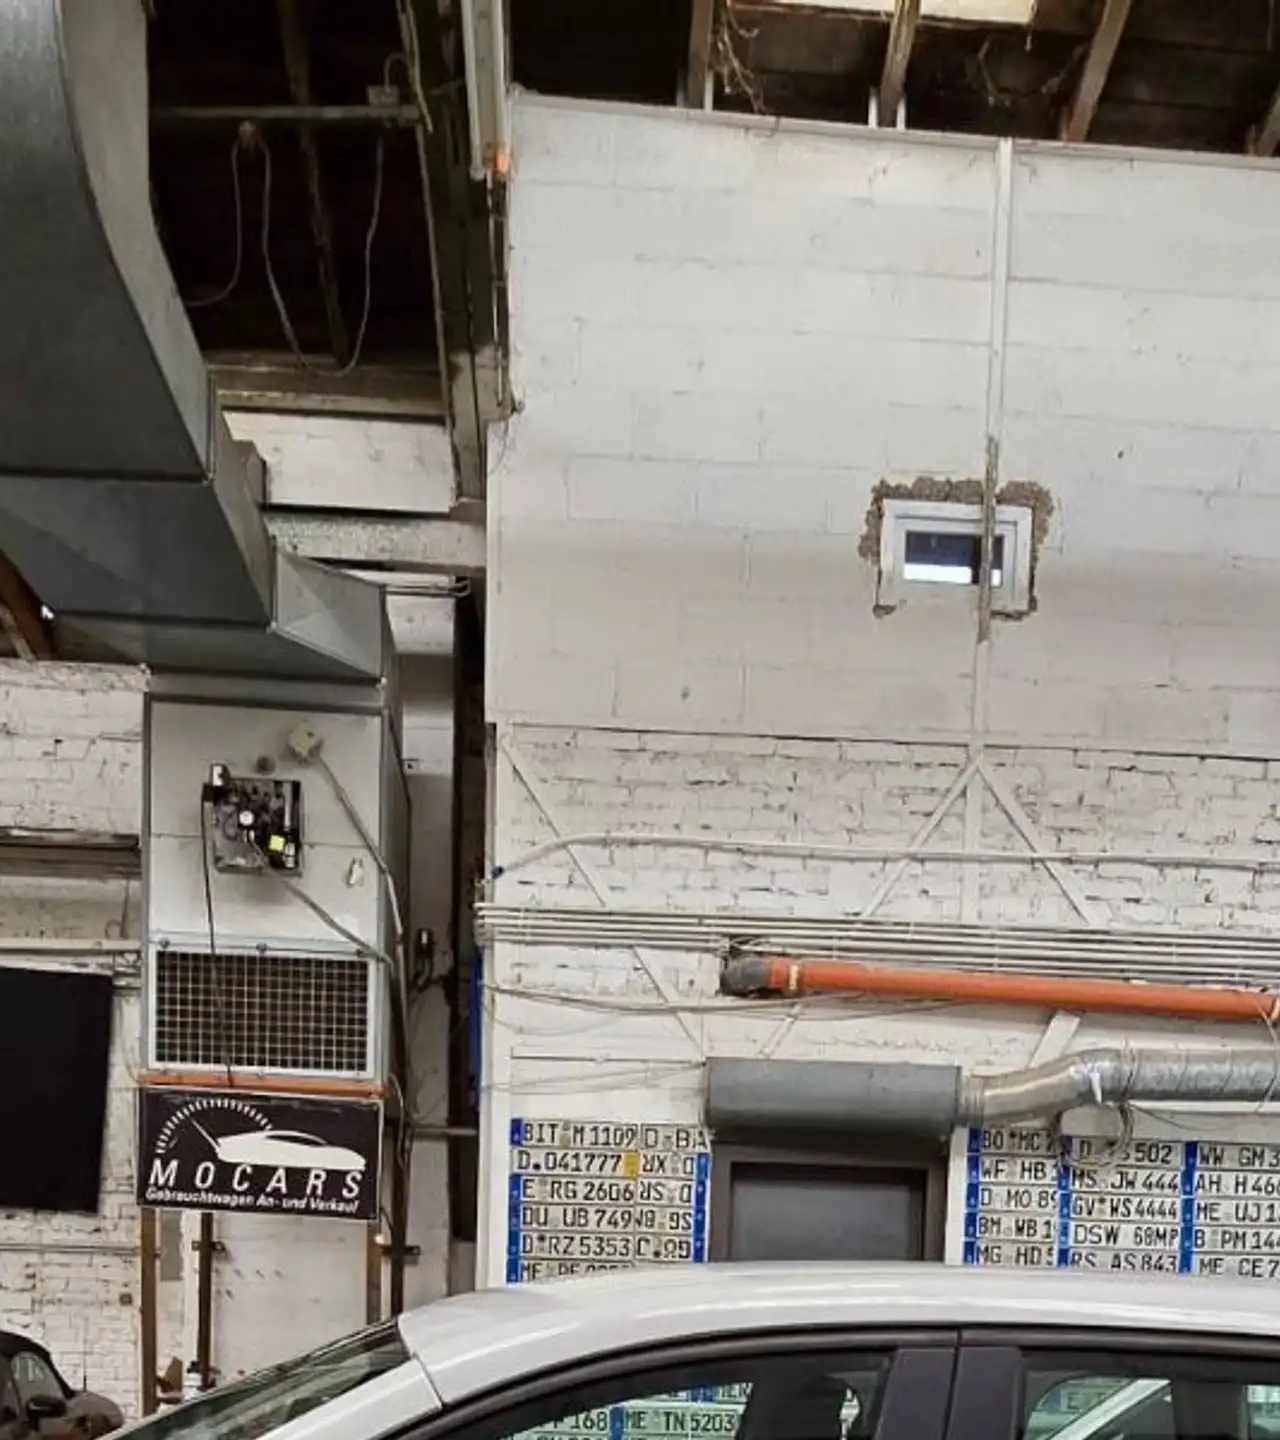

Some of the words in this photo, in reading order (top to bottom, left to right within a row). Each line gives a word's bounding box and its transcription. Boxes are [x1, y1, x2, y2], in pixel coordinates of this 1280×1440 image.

[523, 1123, 558, 1143] BIT
[545, 1152, 622, 1172] 041777
[523, 1179, 535, 1198] E
[551, 1180, 577, 1199] RG
[583, 1181, 634, 1201] 2606
[1142, 1172, 1179, 1192] 444
[145, 1186, 254, 1207] Gebrauchtwagen
[282, 1197, 308, 1210] und
[310, 1199, 360, 1213] Verkauf
[1134, 1199, 1177, 1219] 4444
[522, 1207, 548, 1226] DU
[563, 1207, 588, 1227] UB
[594, 1209, 632, 1228] 749
[1075, 1224, 1120, 1245] DSW
[580, 1236, 631, 1256] 5353
